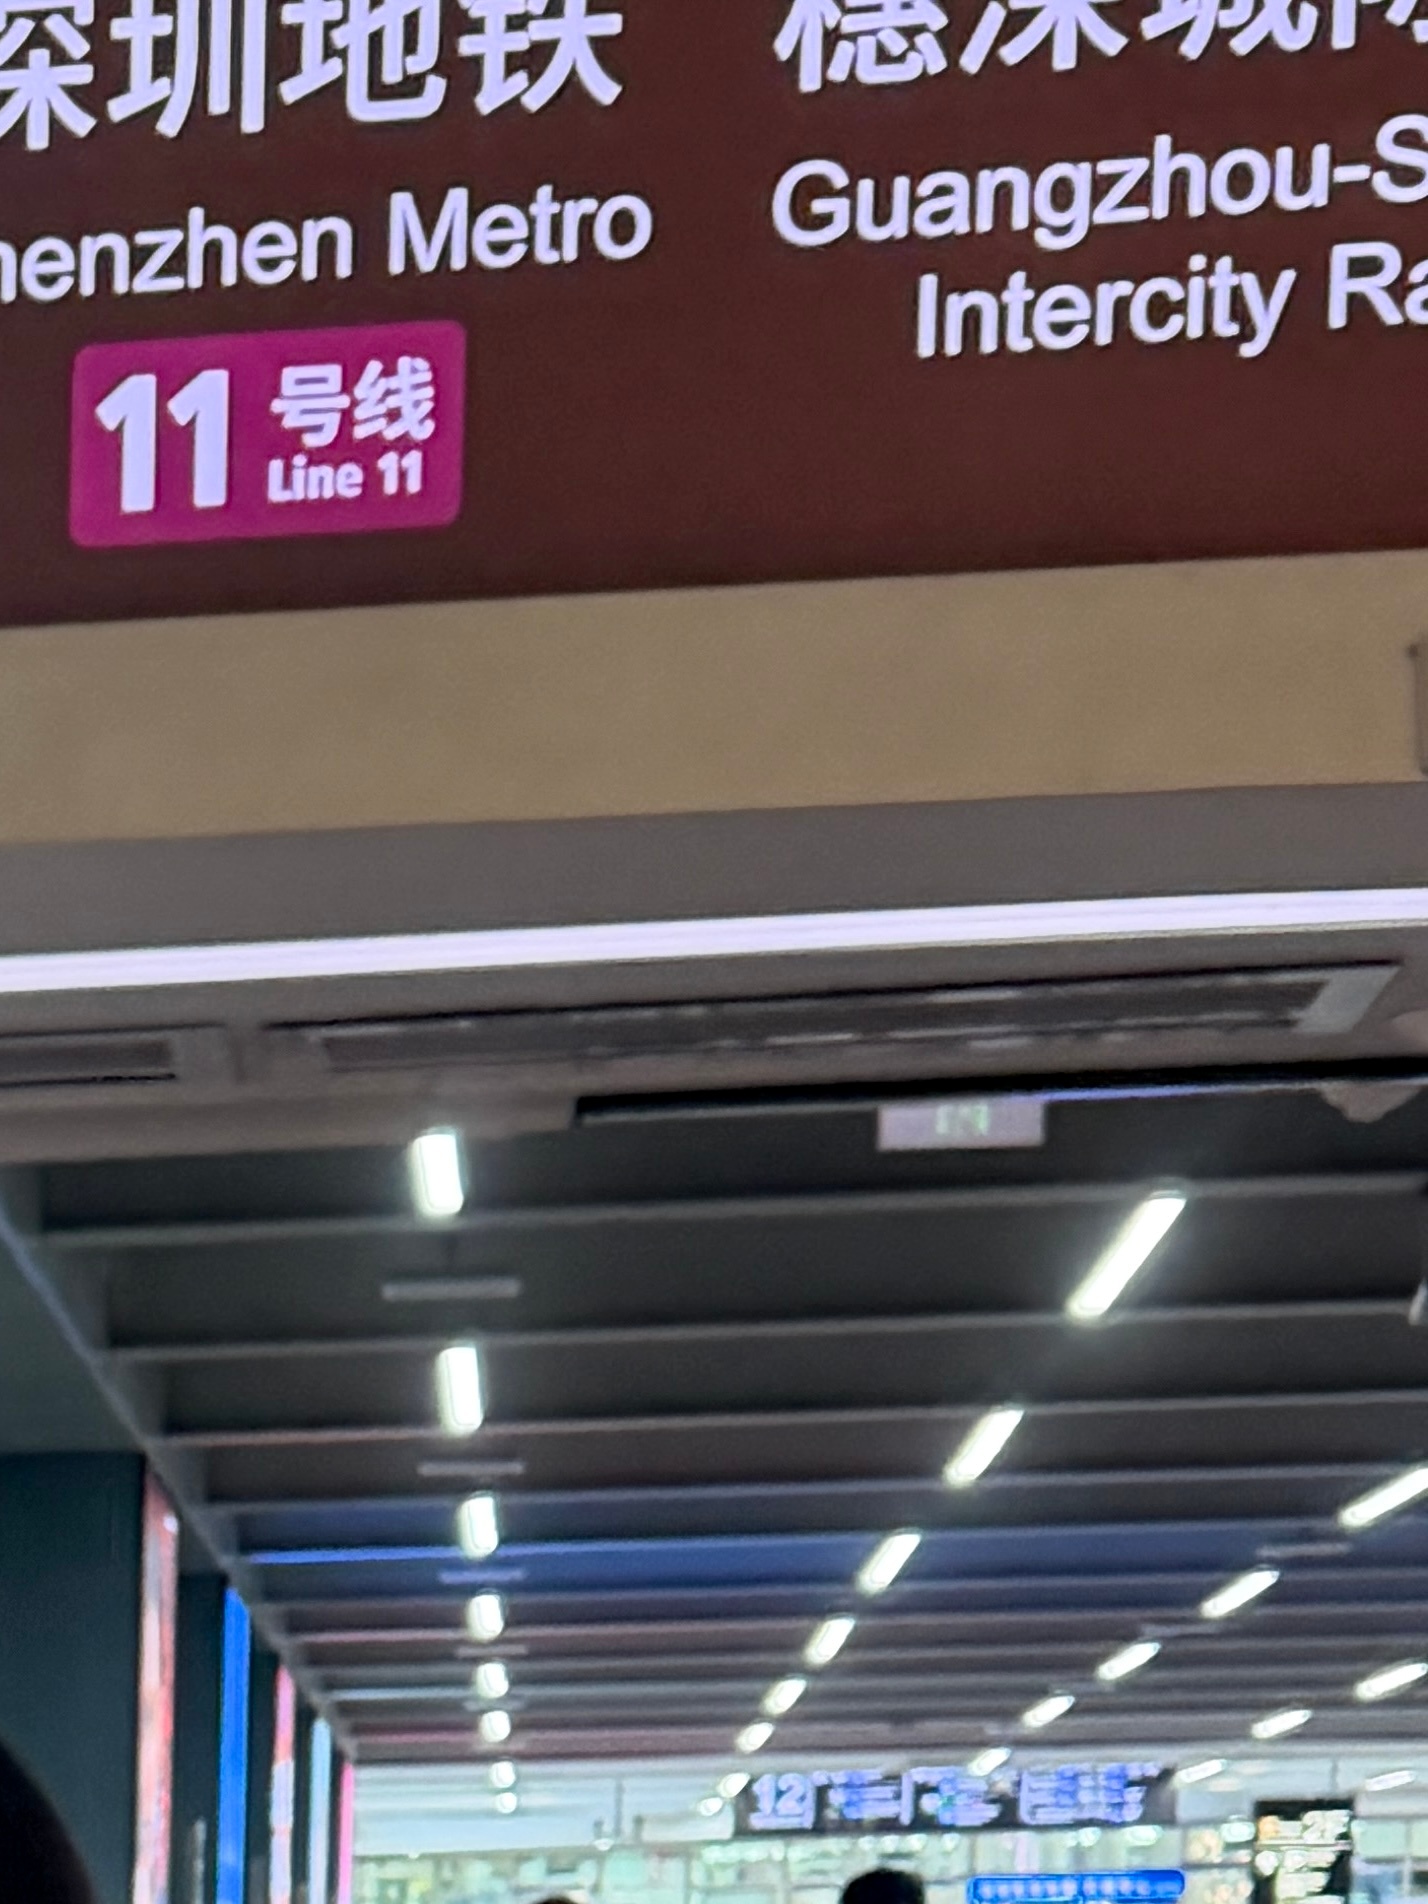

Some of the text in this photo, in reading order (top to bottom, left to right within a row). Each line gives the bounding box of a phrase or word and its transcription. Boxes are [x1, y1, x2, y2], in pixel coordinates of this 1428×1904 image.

[387, 184, 653, 275] Metro
[916, 254, 1298, 358] Intercity
[94, 368, 230, 514] 11
[269, 355, 436, 448] 号线
[267, 449, 423, 503] Line 11
